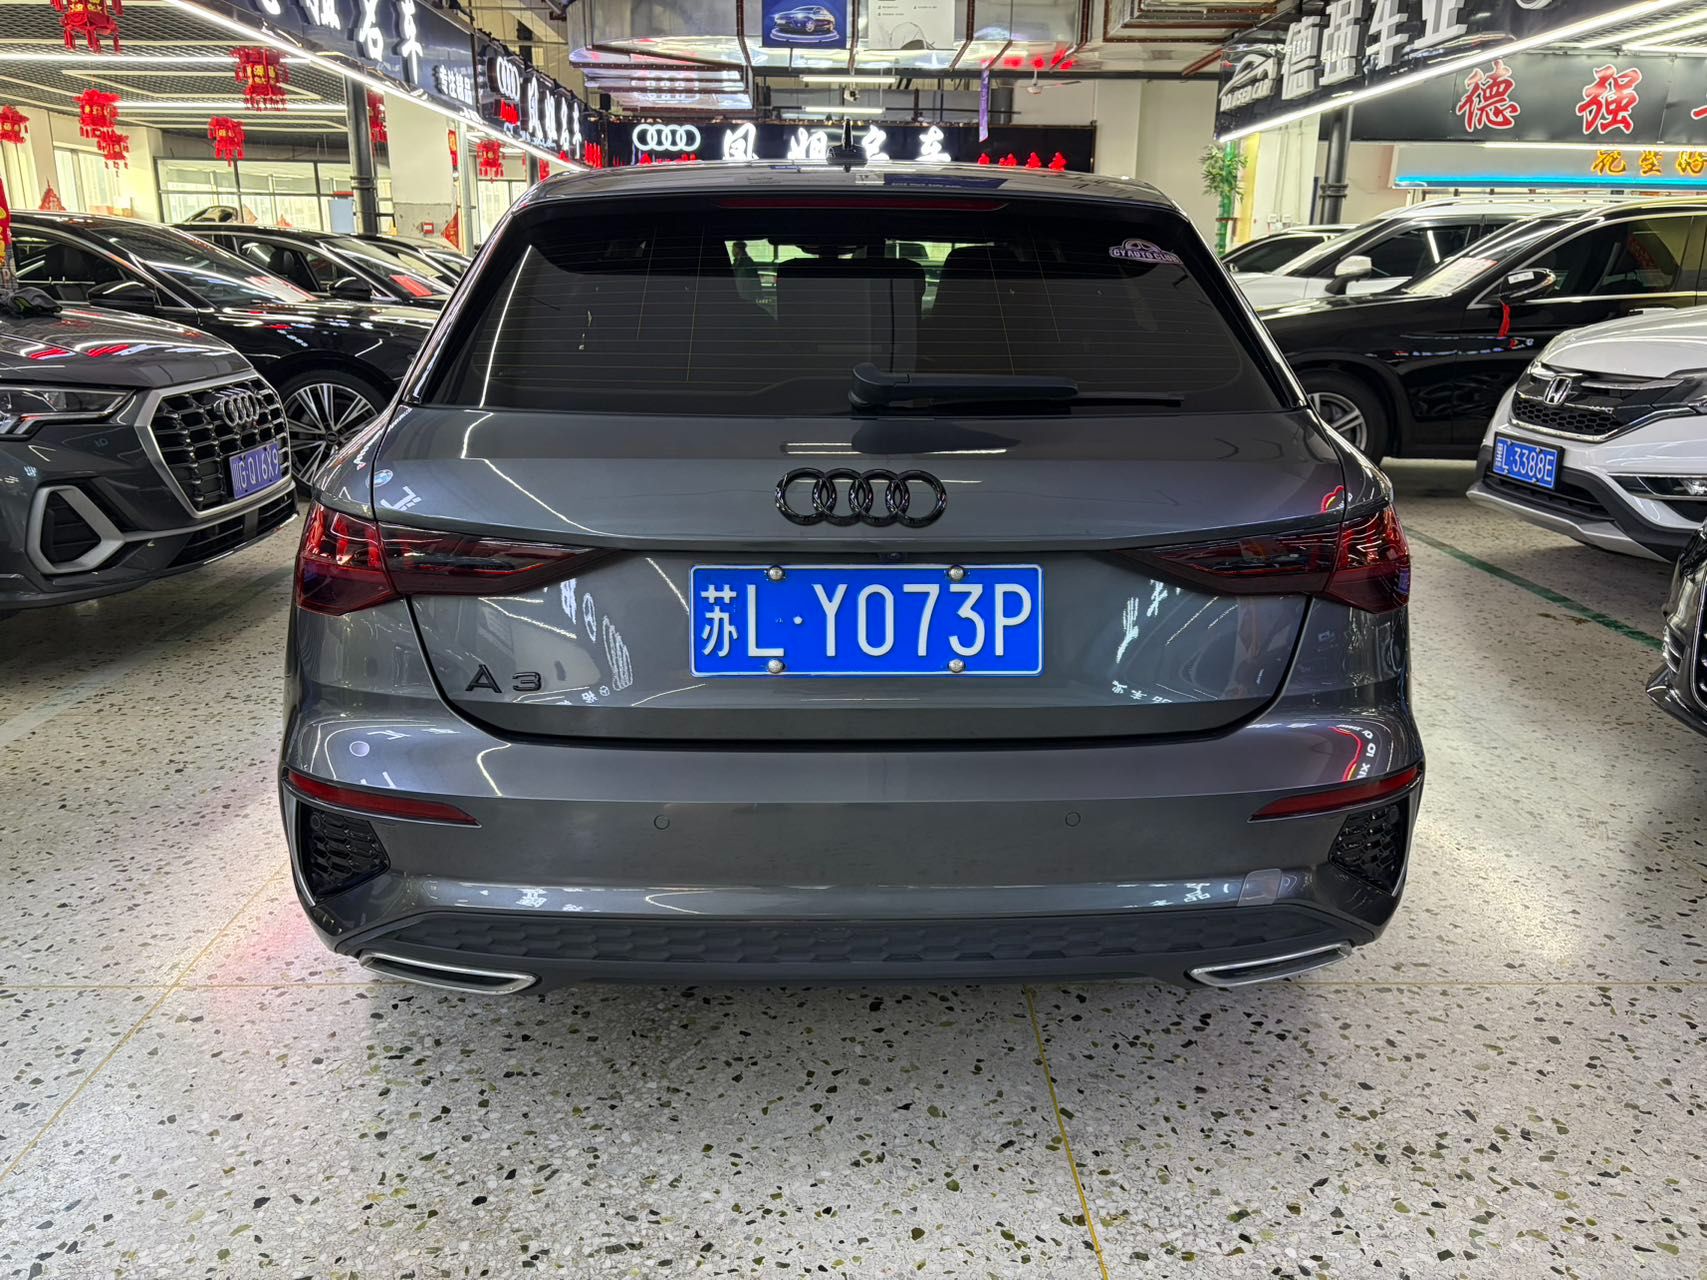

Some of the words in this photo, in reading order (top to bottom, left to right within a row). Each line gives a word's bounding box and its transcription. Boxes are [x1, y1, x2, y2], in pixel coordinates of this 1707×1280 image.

[1456, 58, 1707, 135] 德强
[1127, 250, 1154, 260] AUTO
[701, 584, 1032, 657] 苏L·Y073P
